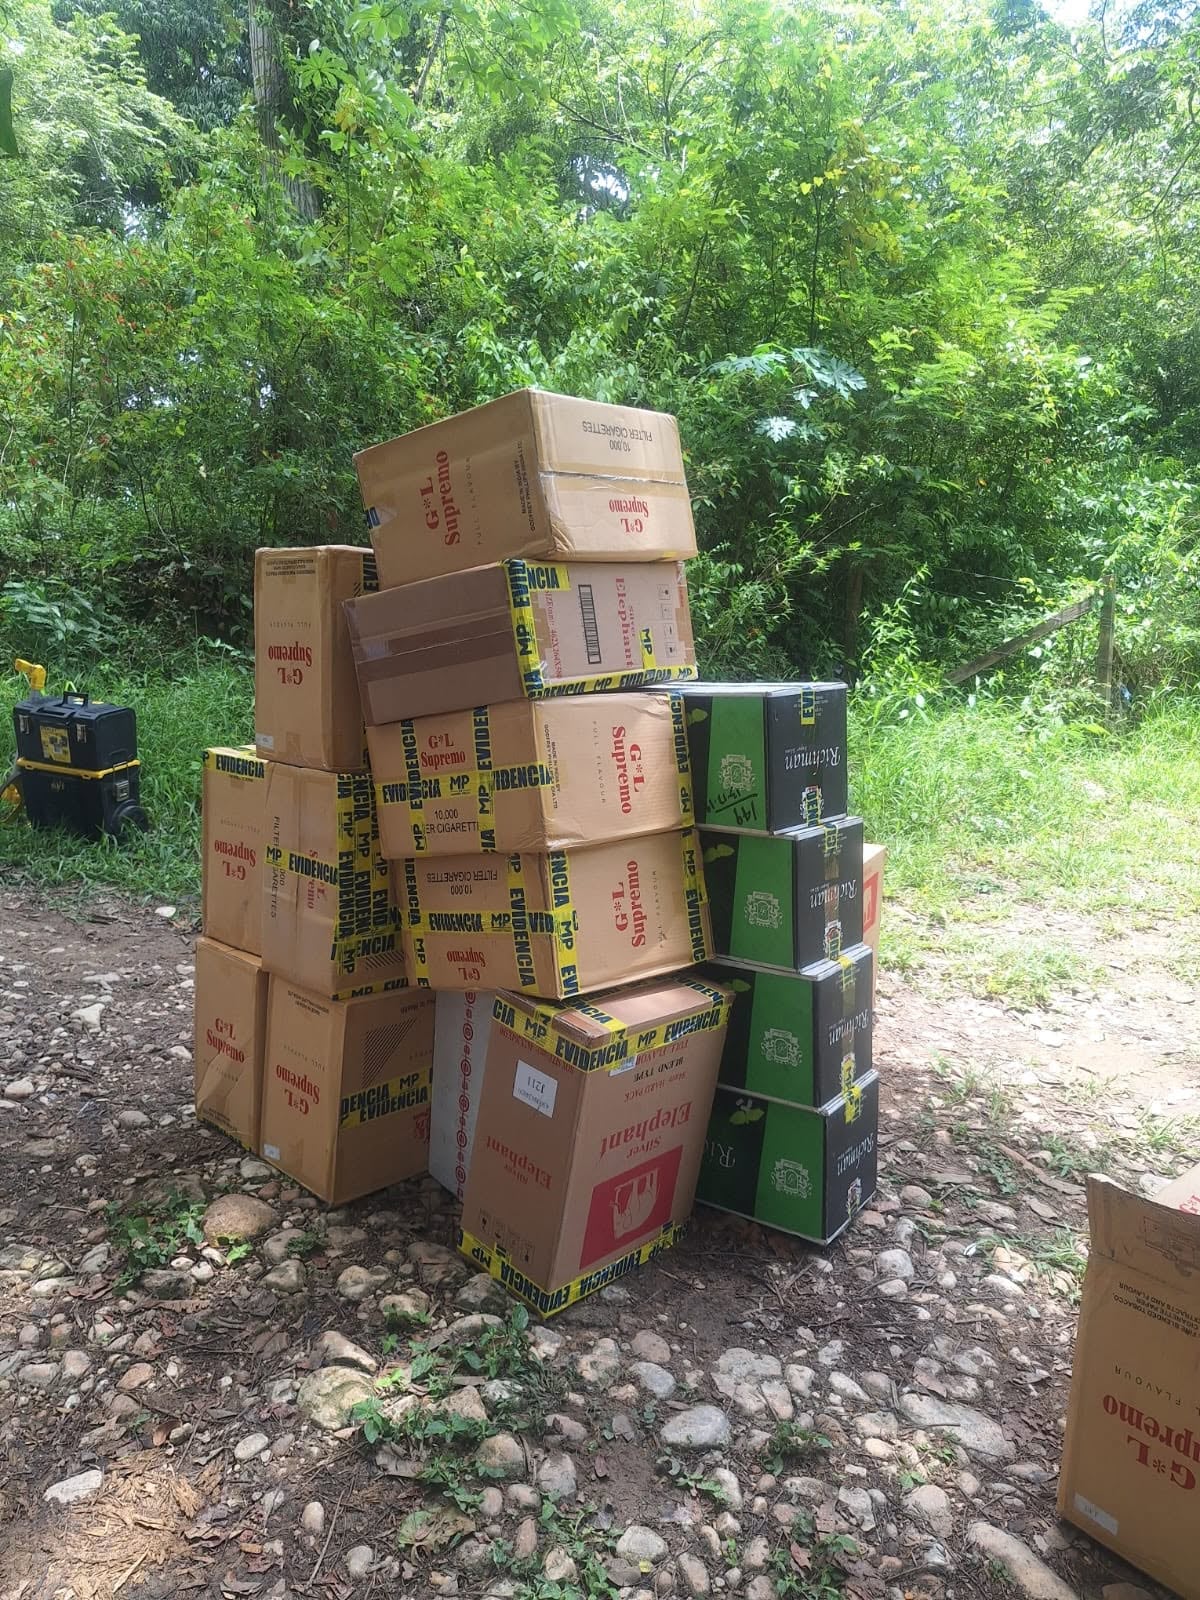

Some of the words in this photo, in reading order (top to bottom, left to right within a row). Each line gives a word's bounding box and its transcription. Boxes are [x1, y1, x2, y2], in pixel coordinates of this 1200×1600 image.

[582, 420, 629, 439] CIGARETTES
[629, 428, 653, 441] FILTER
[609, 440, 631, 452] 10,000
[436, 450, 462, 546] Supremo
[609, 497, 649, 518] Supremo
[615, 578, 635, 667] Elephant
[268, 641, 313, 667] Supremo
[641, 627, 653, 655] MP
[678, 667, 693, 679] MP
[215, 755, 265, 779] EVIDENCIA
[421, 750, 466, 770] Supremo
[611, 726, 632, 814] Supremo
[785, 746, 841, 776] Richman
[450, 775, 470, 791] MP
[478, 784, 491, 814] MP
[680, 787, 690, 814] MP
[343, 811, 354, 838] MP
[434, 809, 459, 821] 10,000
[358, 832, 371, 858] MP
[412, 823, 425, 850] MP
[214, 839, 257, 868] Supremo
[266, 845, 282, 862] MP
[289, 853, 339, 886] EVIDENCIA
[684, 850, 696, 876] MP
[426, 871, 472, 883] CIGARETTES
[473, 870, 499, 881] FILTER
[338, 851, 354, 940] EVIDENCIA
[626, 860, 648, 948] Supremo
[428, 913, 484, 933] EVIDENCIA
[491, 913, 511, 928] MP
[561, 920, 574, 950] MP
[510, 887, 536, 987] EVIDENCIA
[416, 938, 426, 965] MP
[447, 947, 486, 967] Supremo
[206, 1028, 245, 1064] Supremo
[525, 1017, 548, 1038] MP
[556, 1035, 629, 1071] EVIDENCIA
[637, 1030, 658, 1049] MP
[664, 1008, 721, 1043] EVIDENCIA
[633, 1066, 655, 1082] TYPE
[658, 1056, 684, 1073] BLEND
[276, 1063, 320, 1105] Supremo
[400, 1073, 420, 1090] MP
[360, 1086, 429, 1123] EVIDENCIA
[600, 1101, 693, 1160] Elephant
[627, 1136, 662, 1159] Silver
[485, 1135, 553, 1191] Elephant
[472, 1247, 491, 1269] MP
[501, 1261, 571, 1314] EVIDENCIA
[580, 1249, 642, 1296] EVIDENCIA
[1119, 1282, 1149, 1301] FLAVOUR
[1149, 1295, 1166, 1307] AND
[1147, 1311, 1182, 1331] BLENDED
[1159, 1308, 1199, 1330] CIGARETTE
[1114, 1365, 1181, 1406] FLAVOUR
